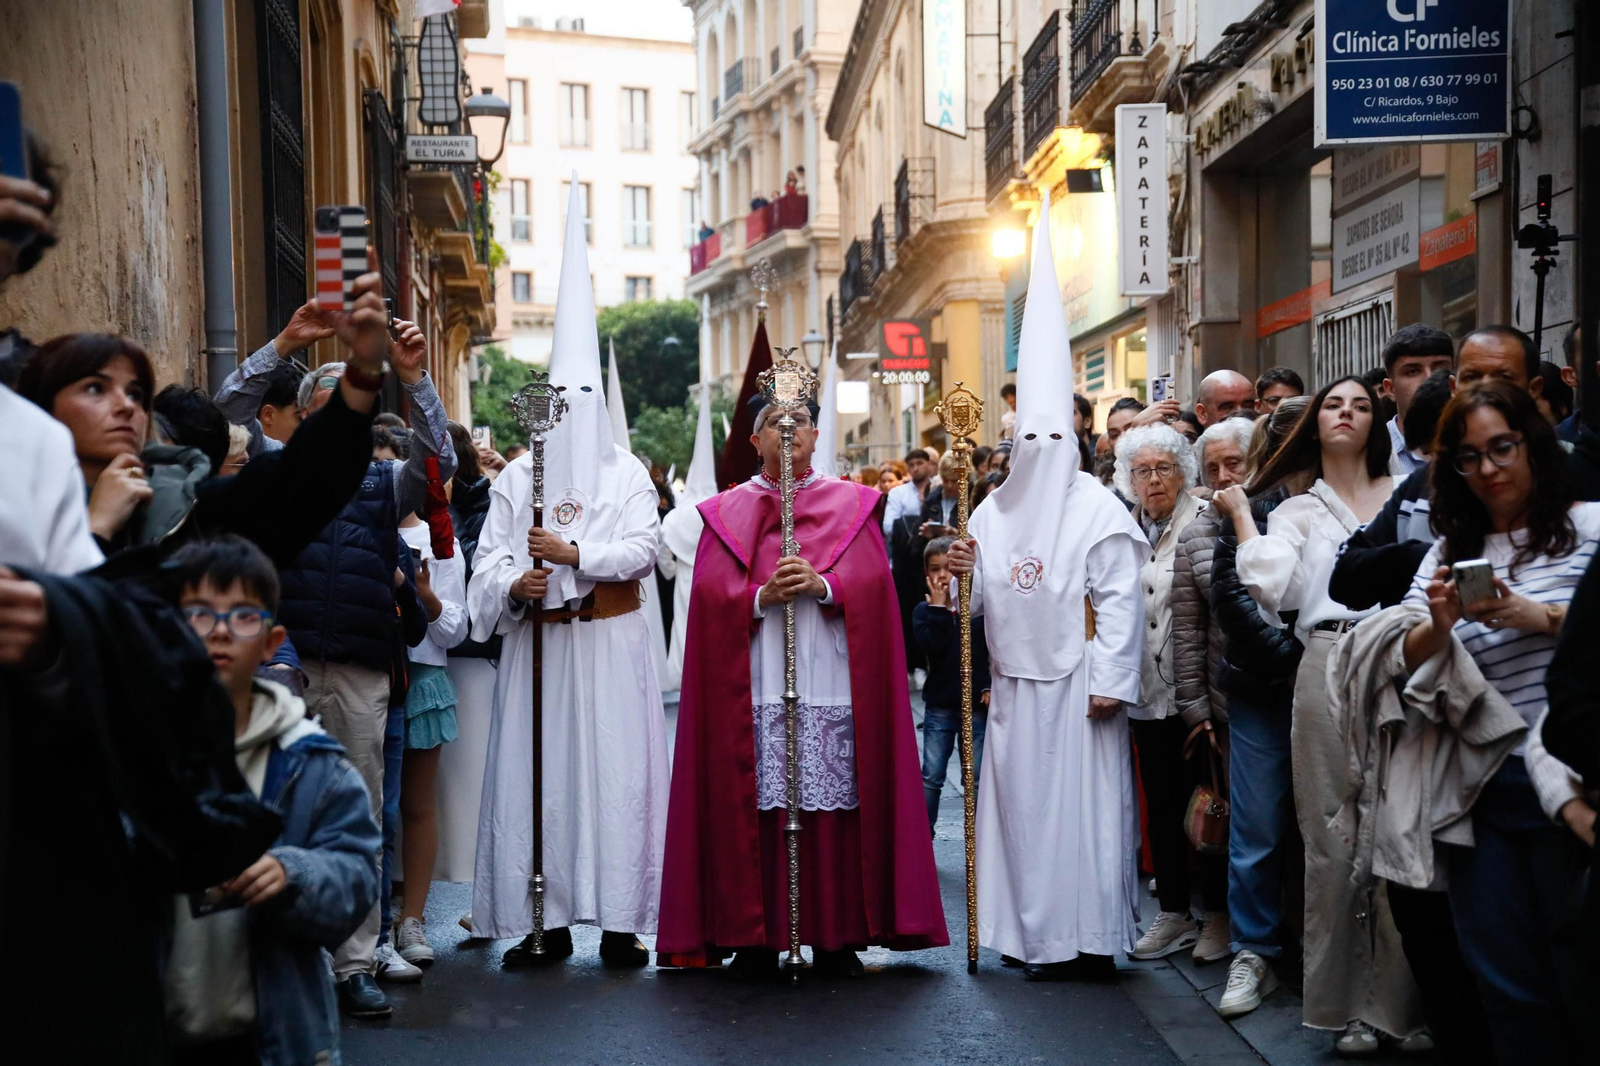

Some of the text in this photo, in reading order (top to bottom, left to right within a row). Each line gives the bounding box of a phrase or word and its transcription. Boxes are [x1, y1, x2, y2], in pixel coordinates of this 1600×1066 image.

[1332, 26, 1500, 53] Clínica Fornieles
[1332, 73, 1498, 90] 950 23 01 08 / 630 77 99 01
[1364, 94, 1459, 107] C/ Ricardos, 9 Bajo
[1352, 111, 1480, 124] www.clinicafornieles.com
[411, 139, 470, 147] RESTAURANTE
[415, 149, 466, 157] EL TURIA
[1137, 115, 1150, 284] ZAPATERÍA
[1346, 200, 1404, 247] ZAPATOS DE SEÑORA
[1341, 252, 1359, 280] DESDE
[1360, 250, 1367, 272] EL
[1375, 243, 1383, 266] 35
[1384, 239, 1391, 262] AL
[1402, 230, 1410, 254] 42
[882, 359, 930, 370] TABACOS
[882, 371, 930, 384] 20:00:00
